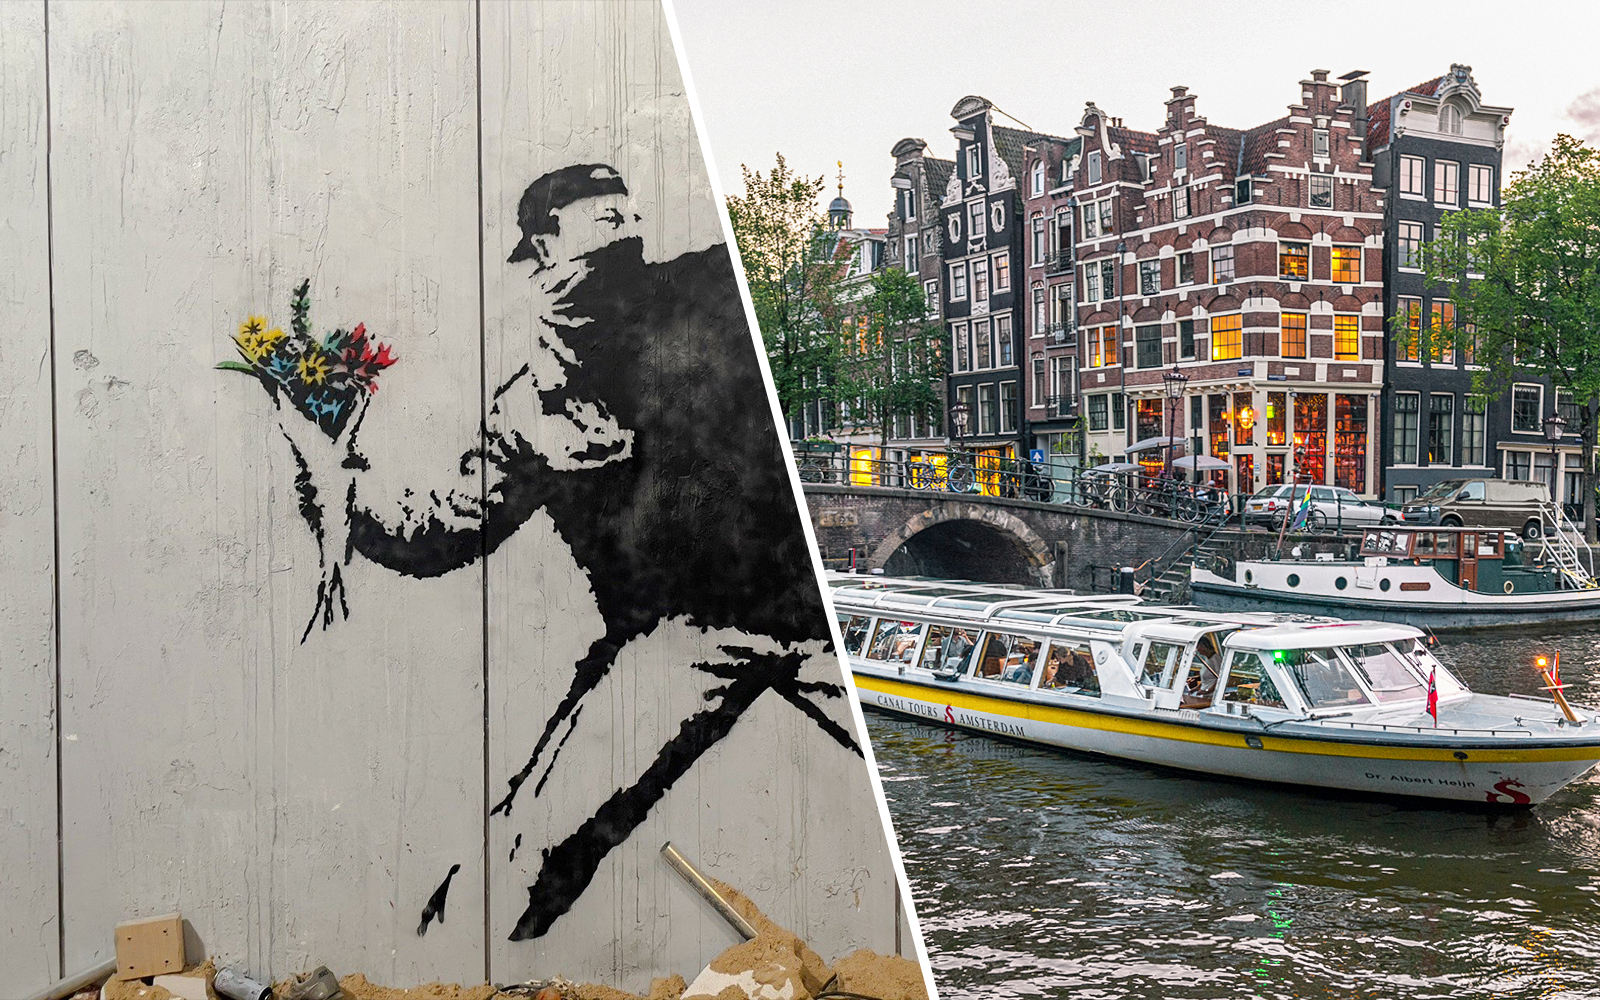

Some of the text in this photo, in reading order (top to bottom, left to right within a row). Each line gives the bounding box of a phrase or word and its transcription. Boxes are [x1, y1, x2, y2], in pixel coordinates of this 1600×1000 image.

[877, 695, 905, 710] CANAL
[908, 702, 938, 717] TOURS
[959, 714, 1025, 737] AMSTERDAM
[1365, 772, 1476, 788] Dr. Albert Heijn
